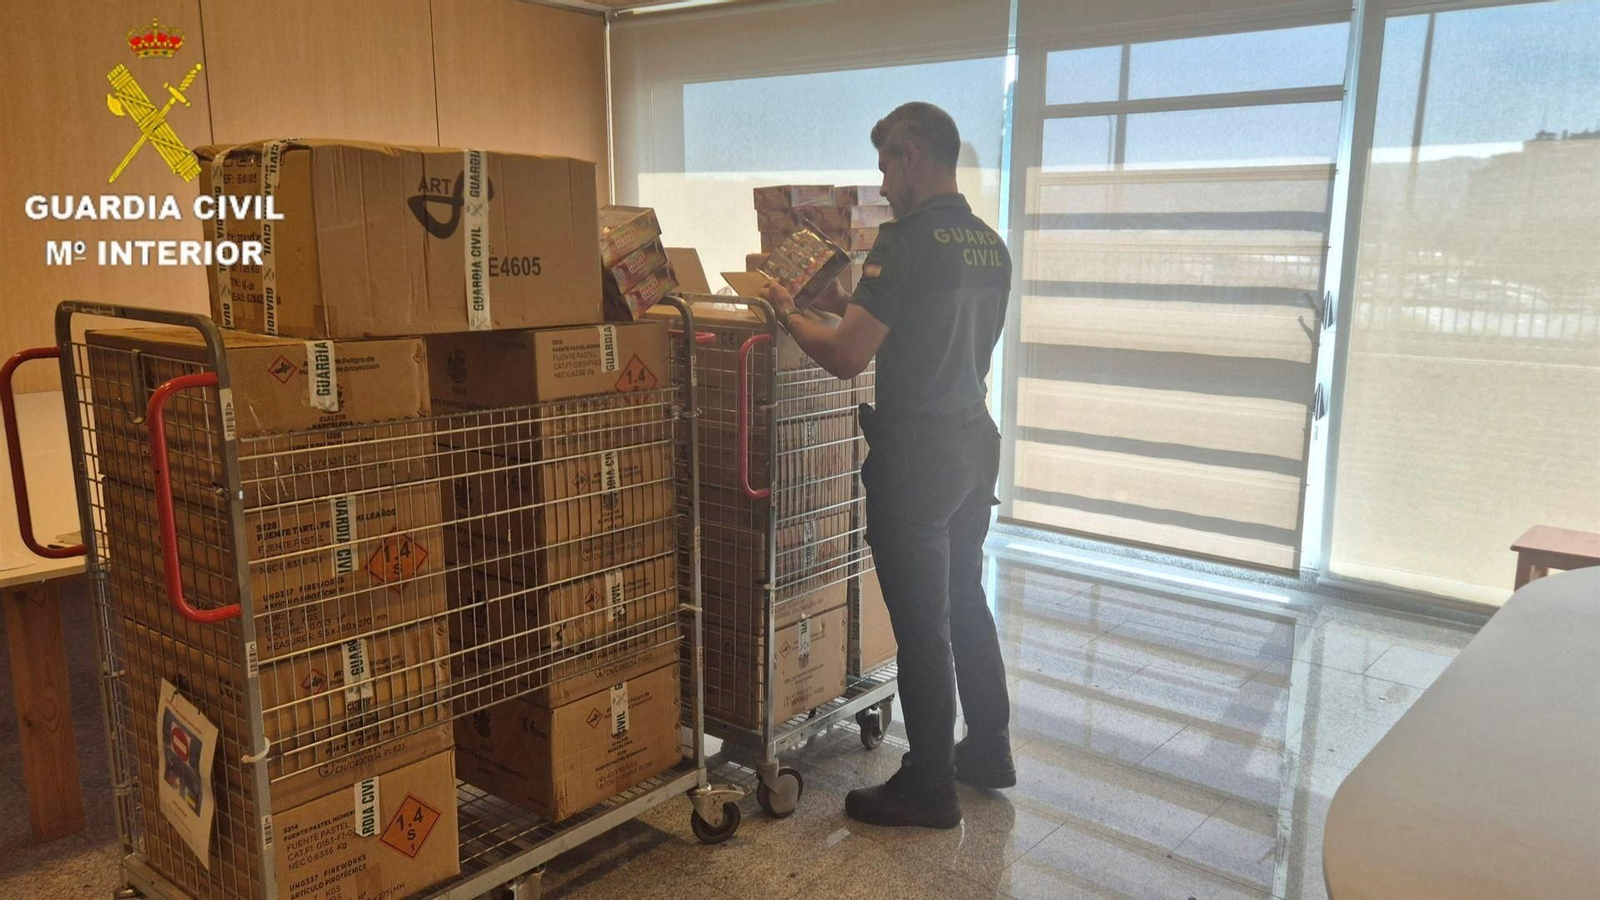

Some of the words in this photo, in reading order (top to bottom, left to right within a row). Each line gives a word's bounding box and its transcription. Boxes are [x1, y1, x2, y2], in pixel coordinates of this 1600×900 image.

[418, 177, 452, 195] ART
[263, 223, 273, 256] CIVIL
[470, 226, 482, 257] CIVIL
[488, 256, 541, 277] E4605
[962, 248, 1002, 267] CIVIL
[470, 261, 485, 311] GUARDIA
[603, 326, 616, 371] GUARDIA
[314, 342, 331, 396] GUARDIA
[626, 368, 646, 385] 1.4
[383, 541, 411, 563] 1.4
[393, 563, 403, 575] S
[396, 806, 424, 831] 1.4
[283, 828, 309, 842] FUENTE
[309, 819, 333, 832] PASTEL
[287, 834, 320, 852] FUENTE
[320, 821, 349, 839] PASTEL
[406, 828, 417, 841] S
[288, 858, 307, 871] NEC
[323, 854, 367, 878] FIREWORKS
[290, 881, 324, 900] ARTÍCULO
[324, 863, 367, 886] PIROTÉCNICO
